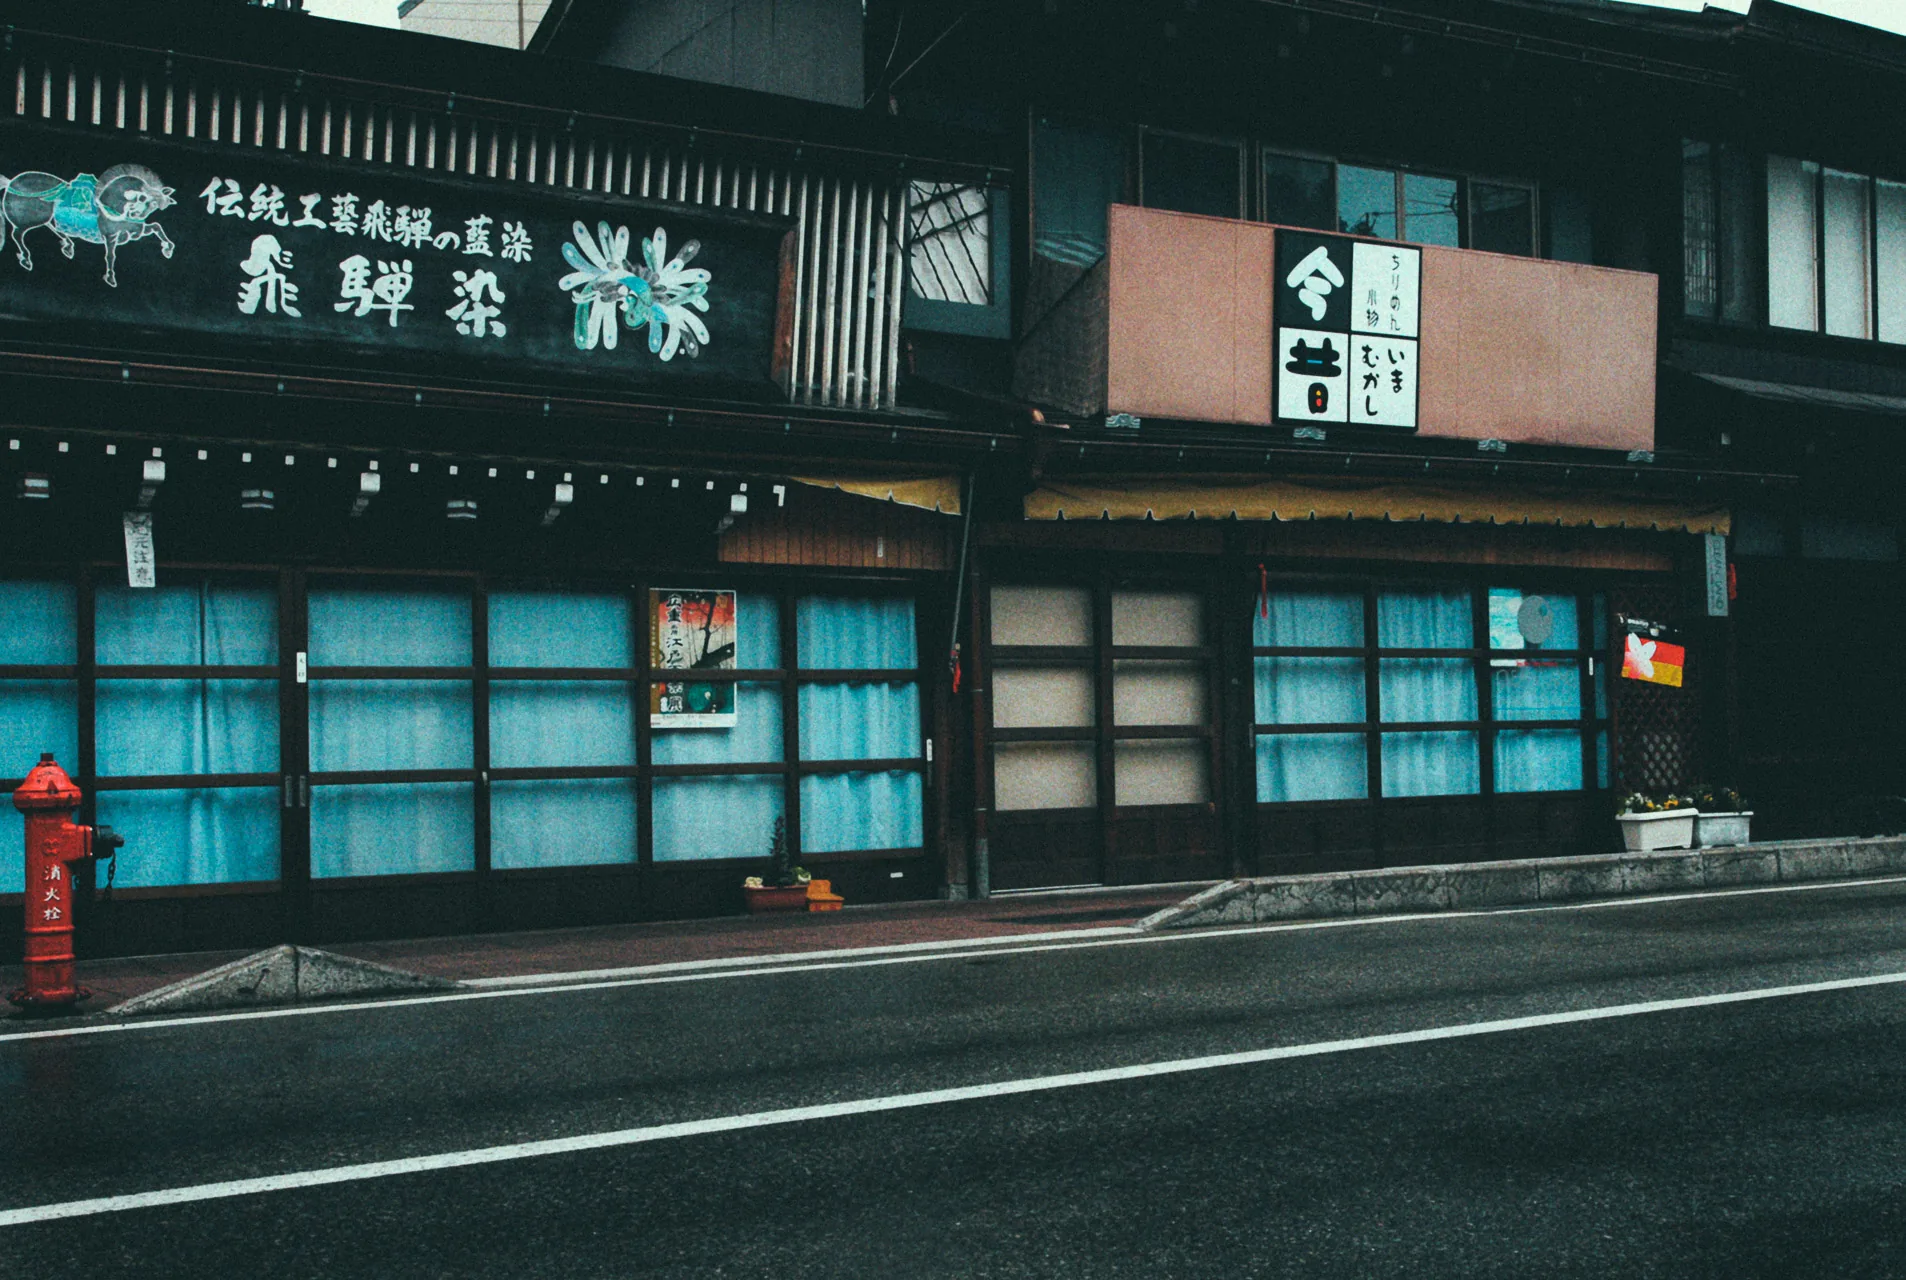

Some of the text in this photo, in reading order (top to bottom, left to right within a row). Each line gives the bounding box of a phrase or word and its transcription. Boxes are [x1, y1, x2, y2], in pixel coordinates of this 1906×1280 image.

[199, 176, 533, 263] 伝統工藝飛騨の藍染
[237, 234, 507, 338] 飛騨染
[1366, 288, 1380, 329] 小物
[1389, 254, 1401, 331] ちりめん
[1361, 344, 1380, 416] むかし
[1388, 348, 1405, 394] いま
[43, 864, 62, 920] 消火栓
